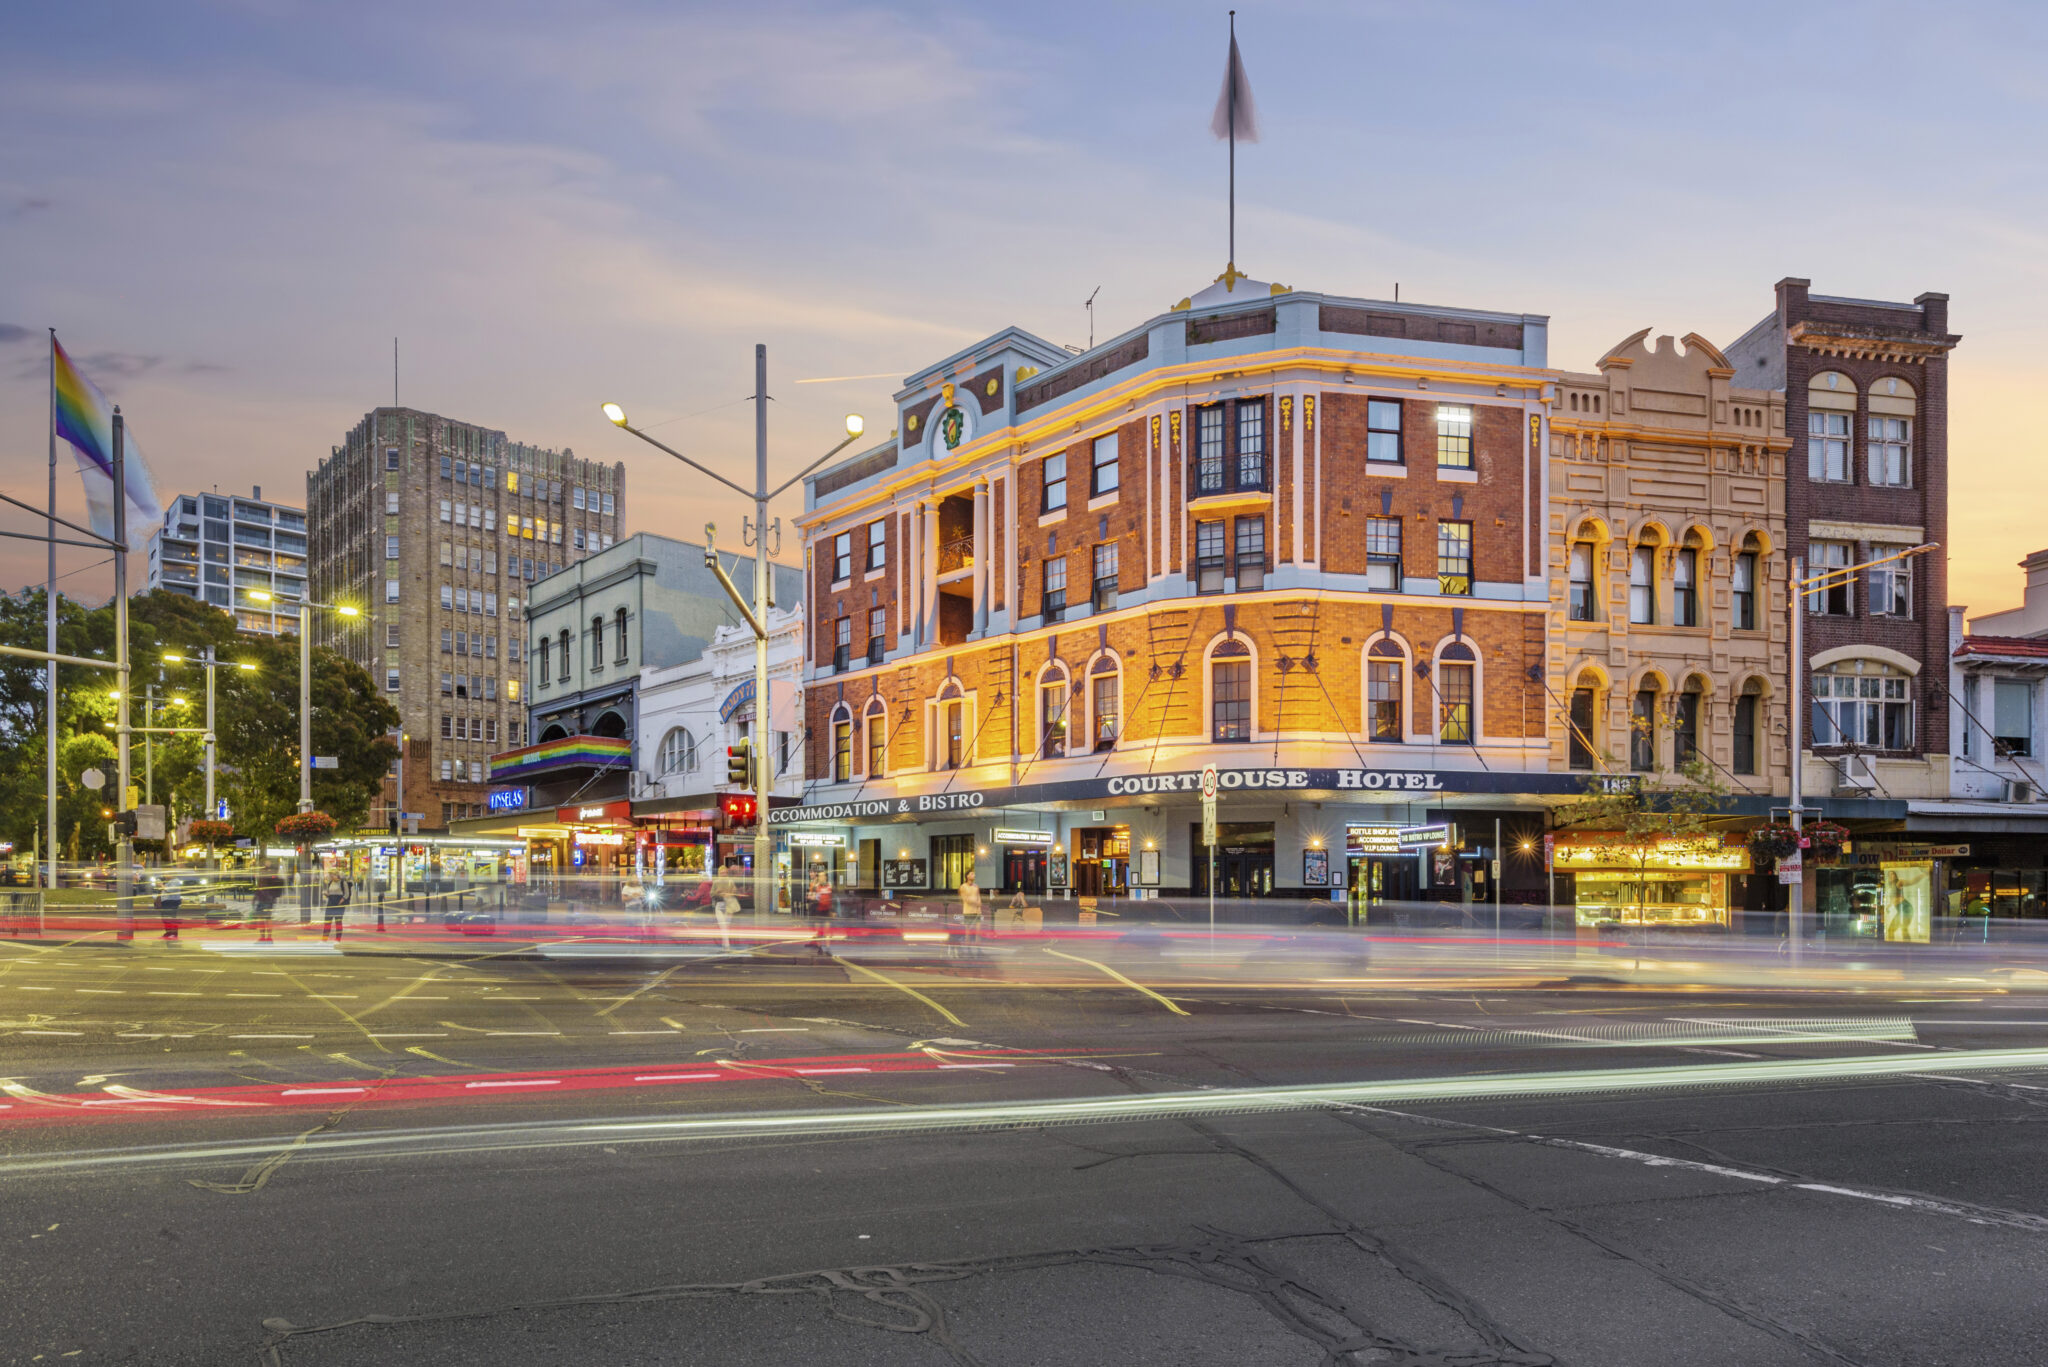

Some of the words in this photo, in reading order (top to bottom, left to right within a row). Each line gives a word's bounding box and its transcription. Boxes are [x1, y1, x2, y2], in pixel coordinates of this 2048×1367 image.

[1205, 776, 1214, 789] 40
[1337, 770, 1443, 789] HOTEL
[897, 799, 910, 812] &
[919, 792, 984, 811] BISTRO
[1429, 831, 1445, 839] LOUNGE
[1931, 847, 1955, 855] Dollar
